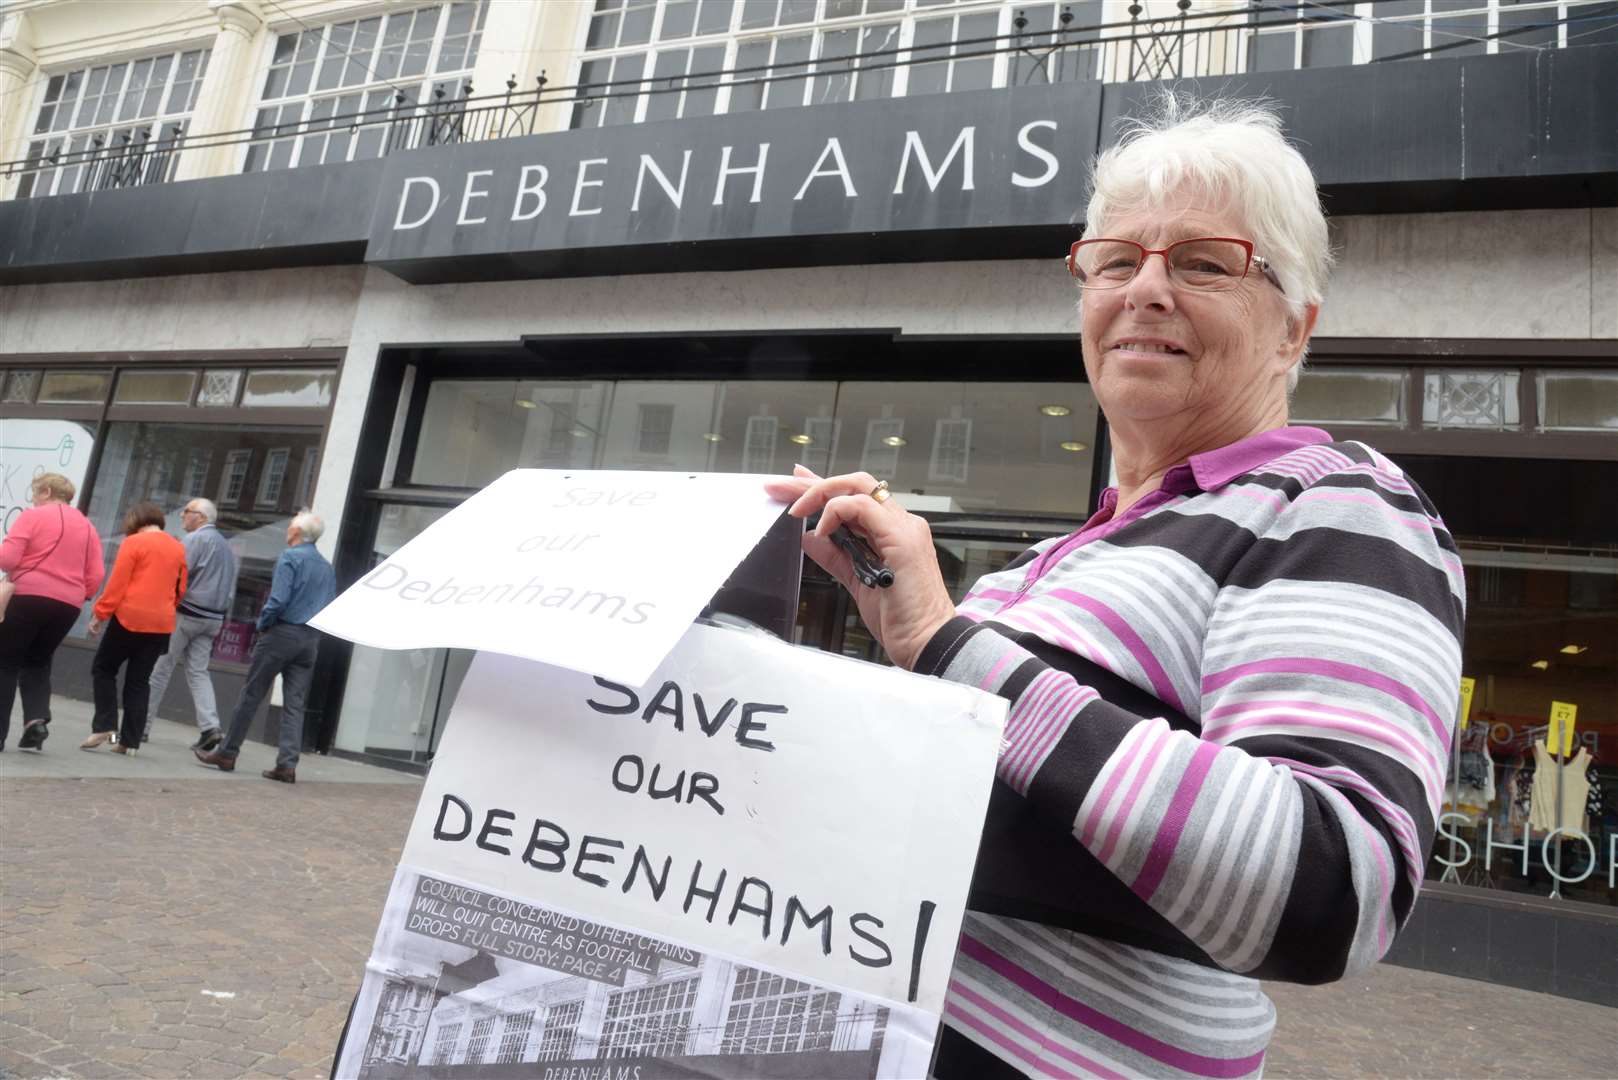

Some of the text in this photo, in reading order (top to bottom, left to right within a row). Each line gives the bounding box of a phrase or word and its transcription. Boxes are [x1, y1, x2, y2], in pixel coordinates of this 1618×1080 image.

[393, 119, 1060, 231] DEBENHAMS
[517, 532, 600, 552] our
[362, 562, 656, 624] Debenhams
[586, 674, 789, 752] SAVE
[612, 754, 724, 815] OUR
[408, 914, 622, 982] DROPS FULL STORY: PAGE 4
[415, 895, 652, 971] WILL QUIT CENTRE AS FOOTFALL
[420, 879, 694, 962] COUNCIL CONCERNED OTHER CHAINS
